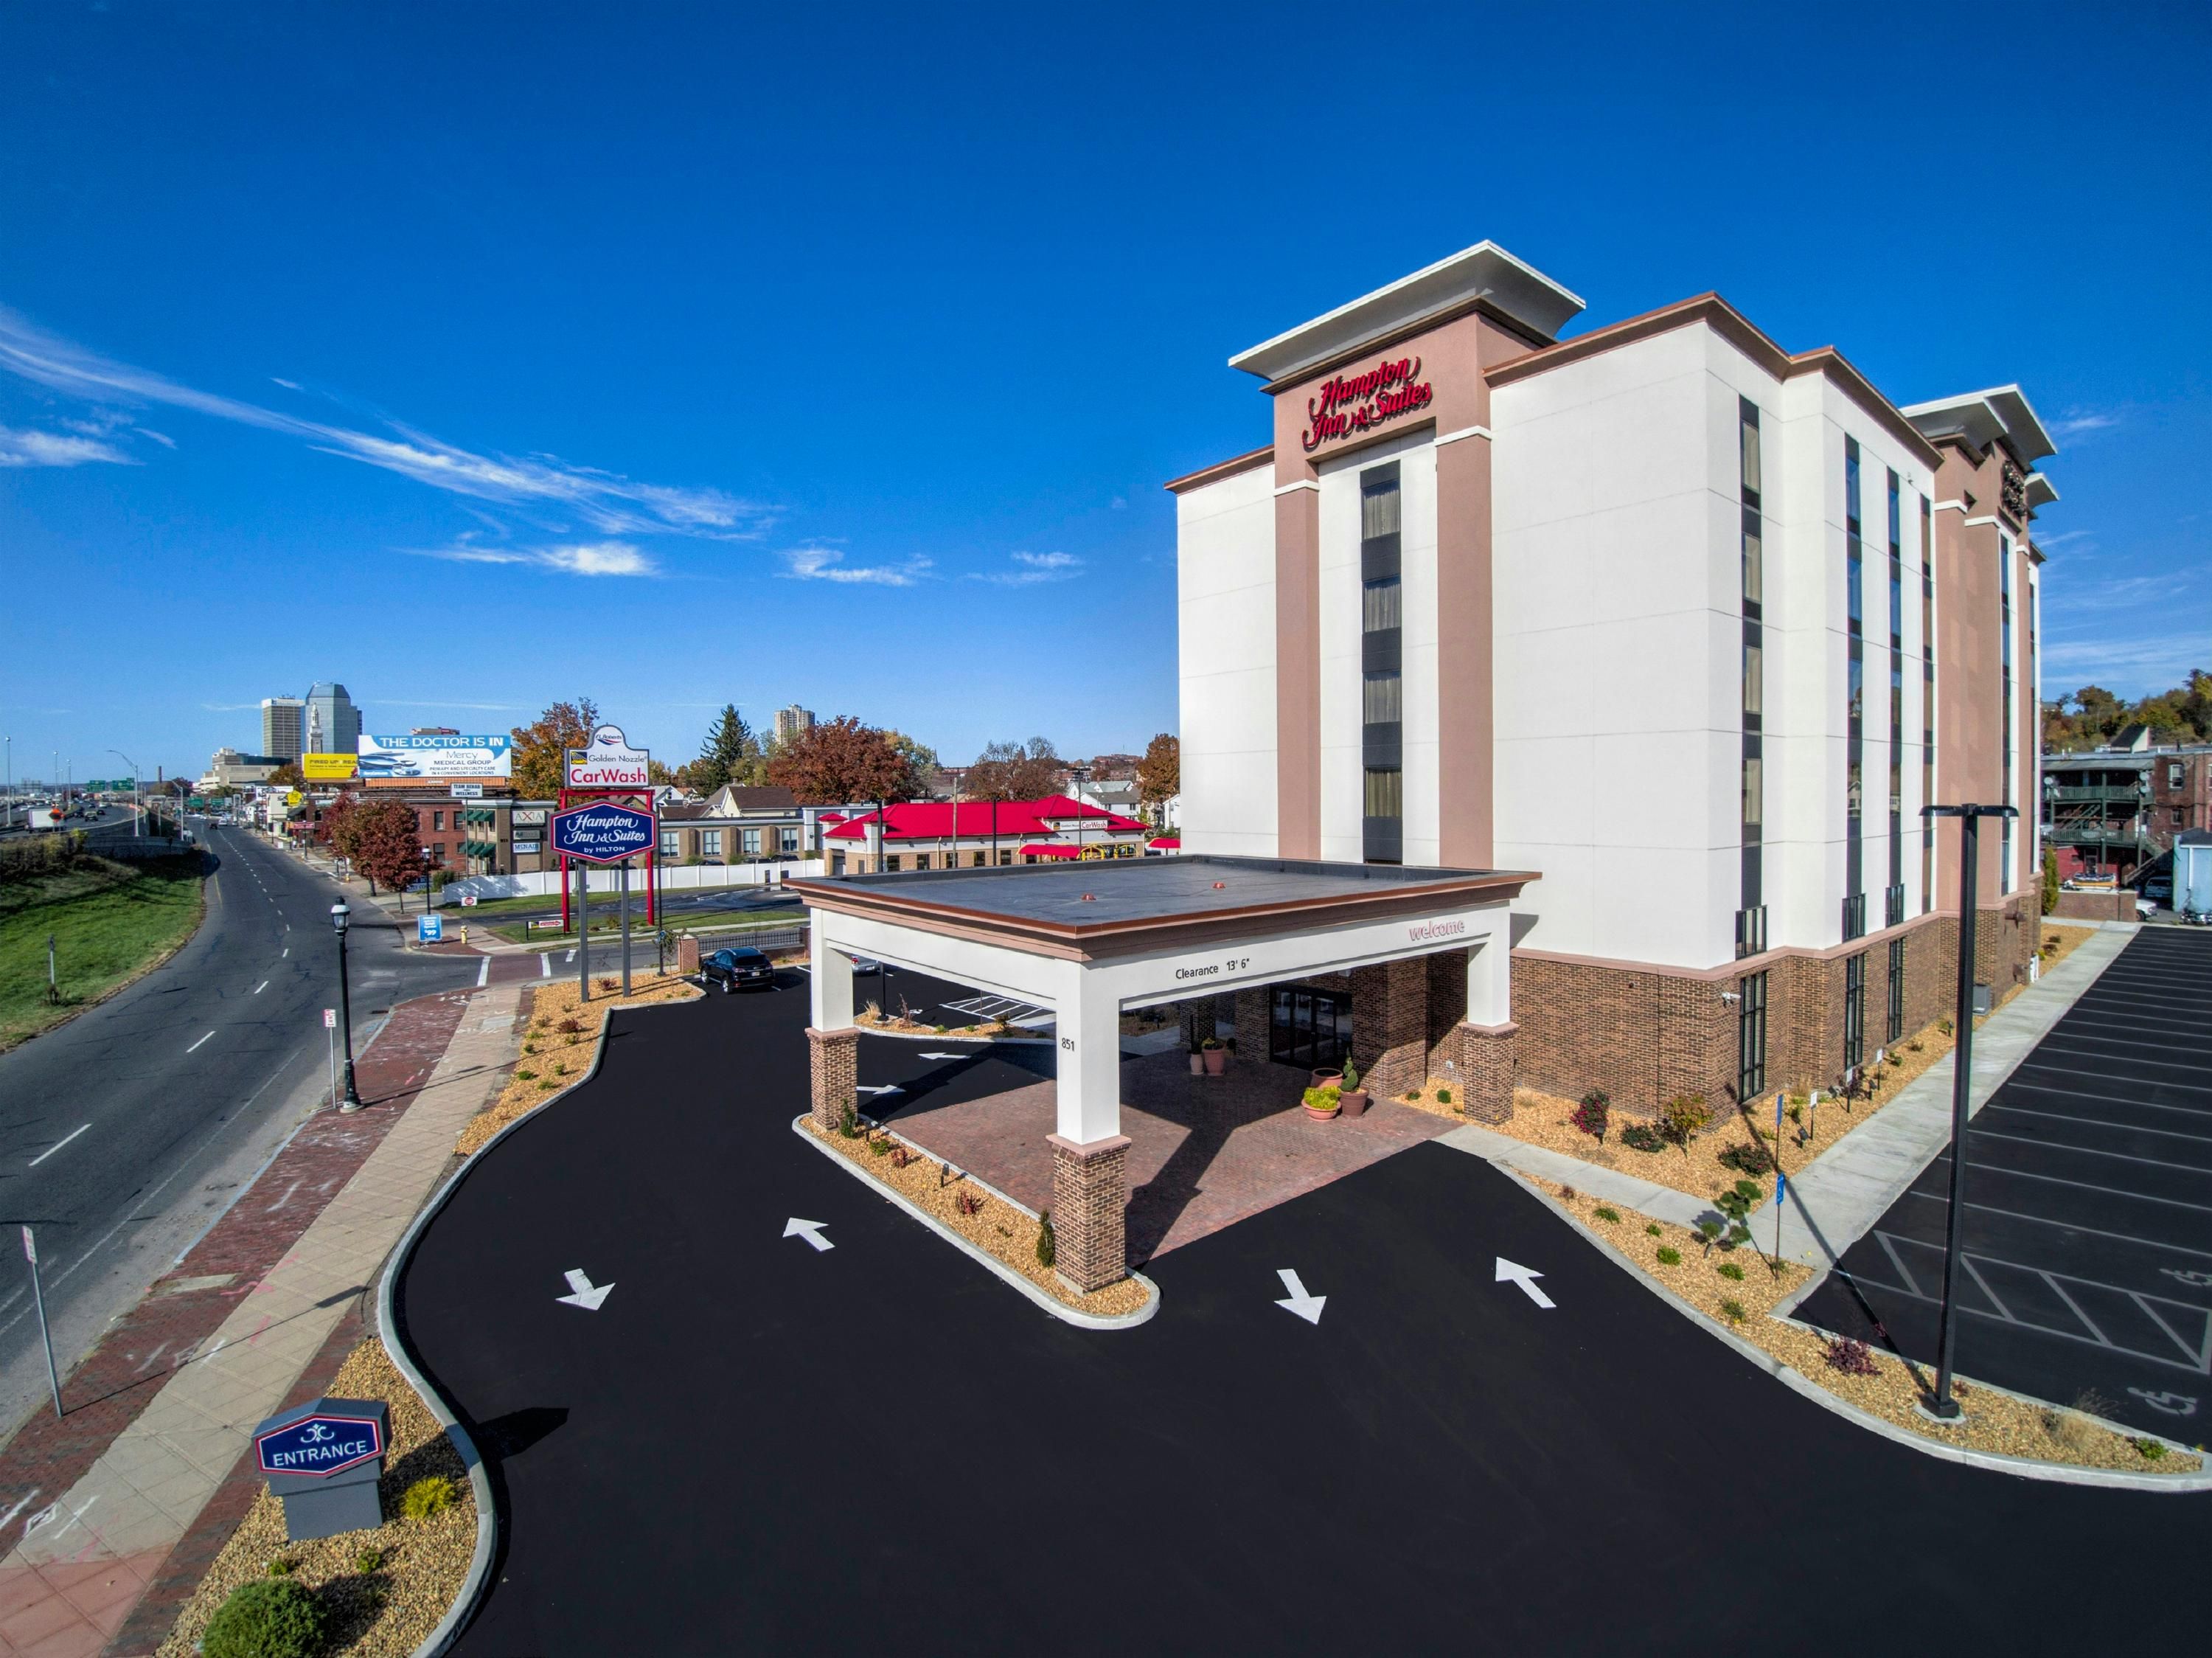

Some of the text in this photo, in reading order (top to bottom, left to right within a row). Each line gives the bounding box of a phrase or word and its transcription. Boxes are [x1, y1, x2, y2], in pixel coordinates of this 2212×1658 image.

[1309, 356, 1421, 417] Hampton
[1302, 381, 1433, 447] Inn & Suites
[380, 738, 504, 747] THE DOCTOR IS IN
[446, 751, 479, 760] Mercy
[588, 755, 616, 763] Golden
[571, 767, 647, 783] CarWash
[567, 814, 639, 832] Hampton
[564, 830, 646, 844] Inn & Suites
[1409, 920, 1466, 941] welcome
[1175, 965, 1219, 979] Clearance
[1062, 1037, 1075, 1052] 851
[272, 1440, 367, 1467] ENTRANCE
